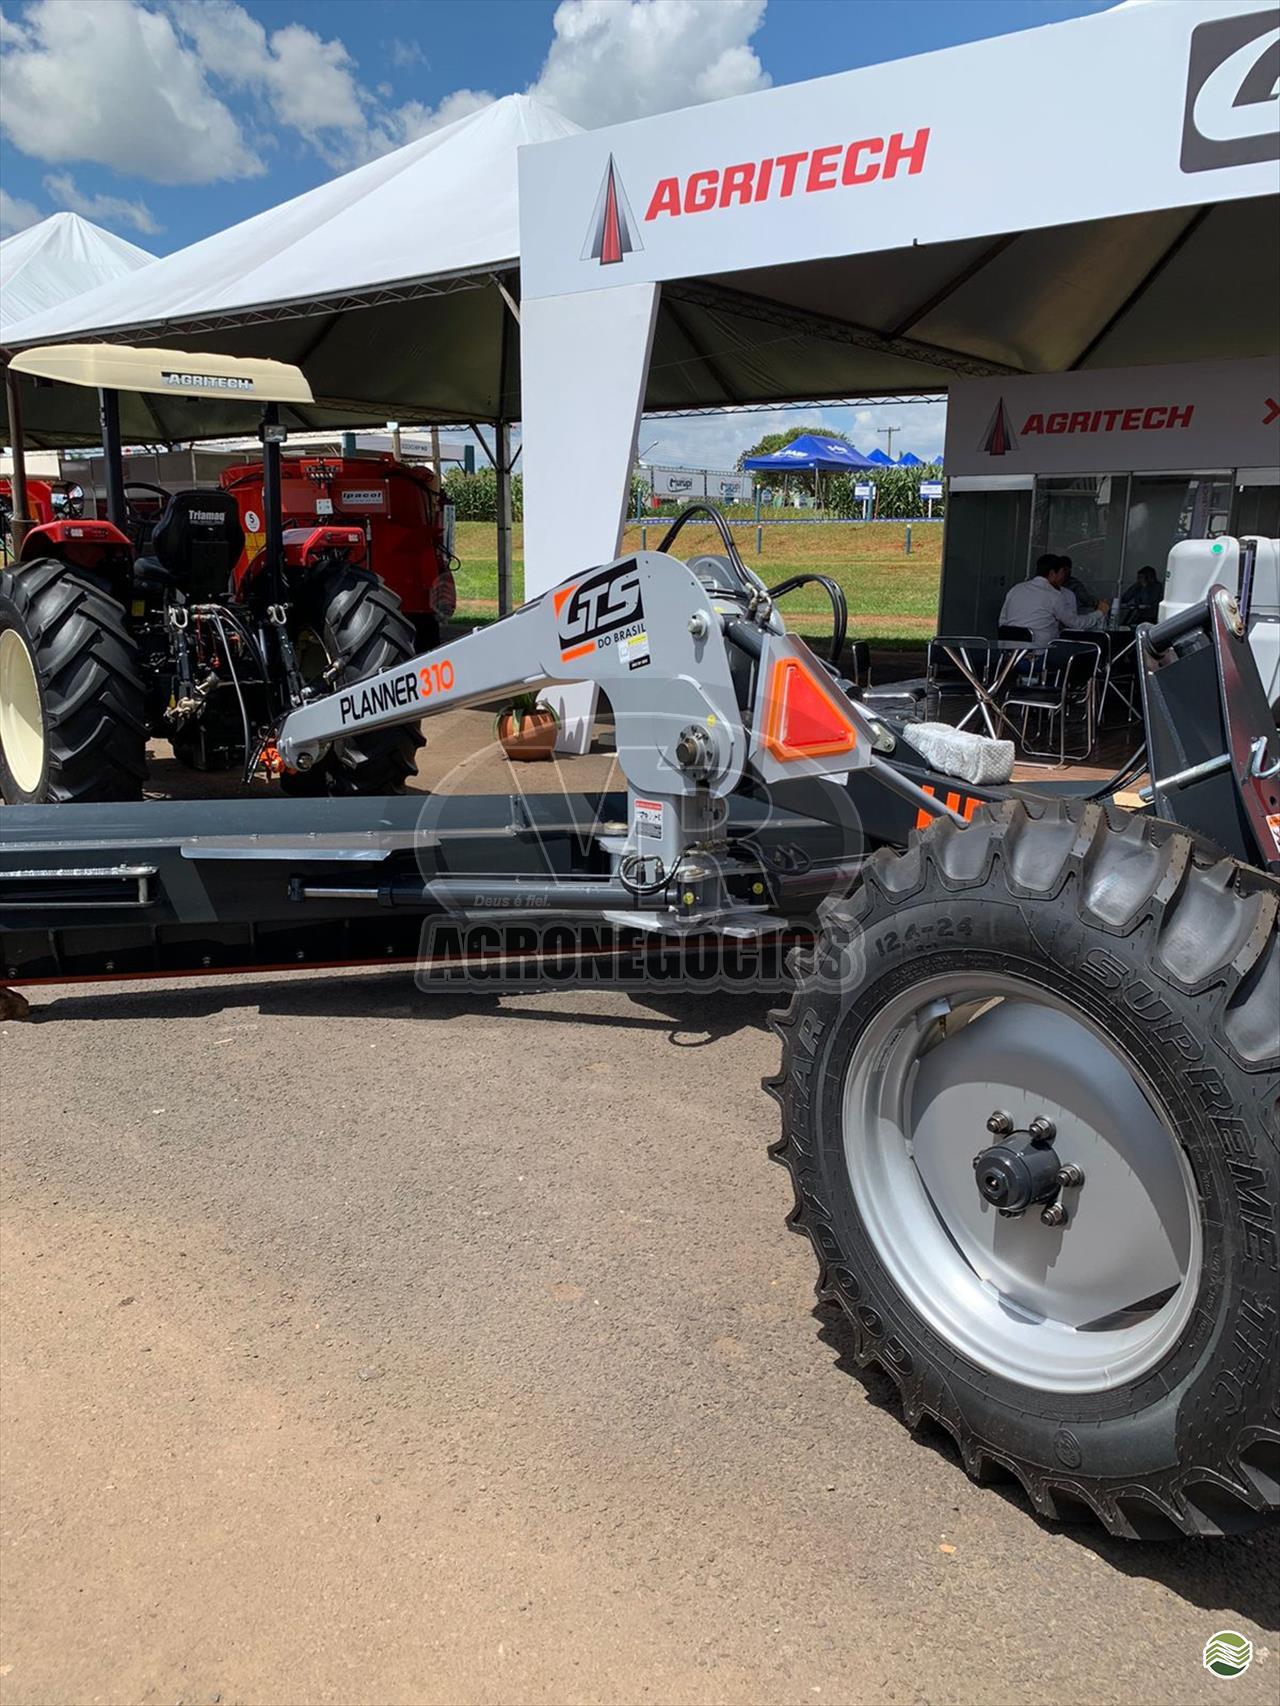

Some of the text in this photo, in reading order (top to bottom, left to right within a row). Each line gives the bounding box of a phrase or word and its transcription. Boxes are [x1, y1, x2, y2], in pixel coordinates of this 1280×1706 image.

[644, 127, 931, 222] AGRITECH
[168, 373, 250, 390] AGRITECH
[1020, 404, 1195, 436] AGRITECH
[559, 566, 642, 641] GTS
[597, 635, 612, 649] DO
[614, 622, 647, 644] BRASIL
[339, 660, 455, 725] PLANNER 310
[1079, 946, 1278, 1274] SUPREME
